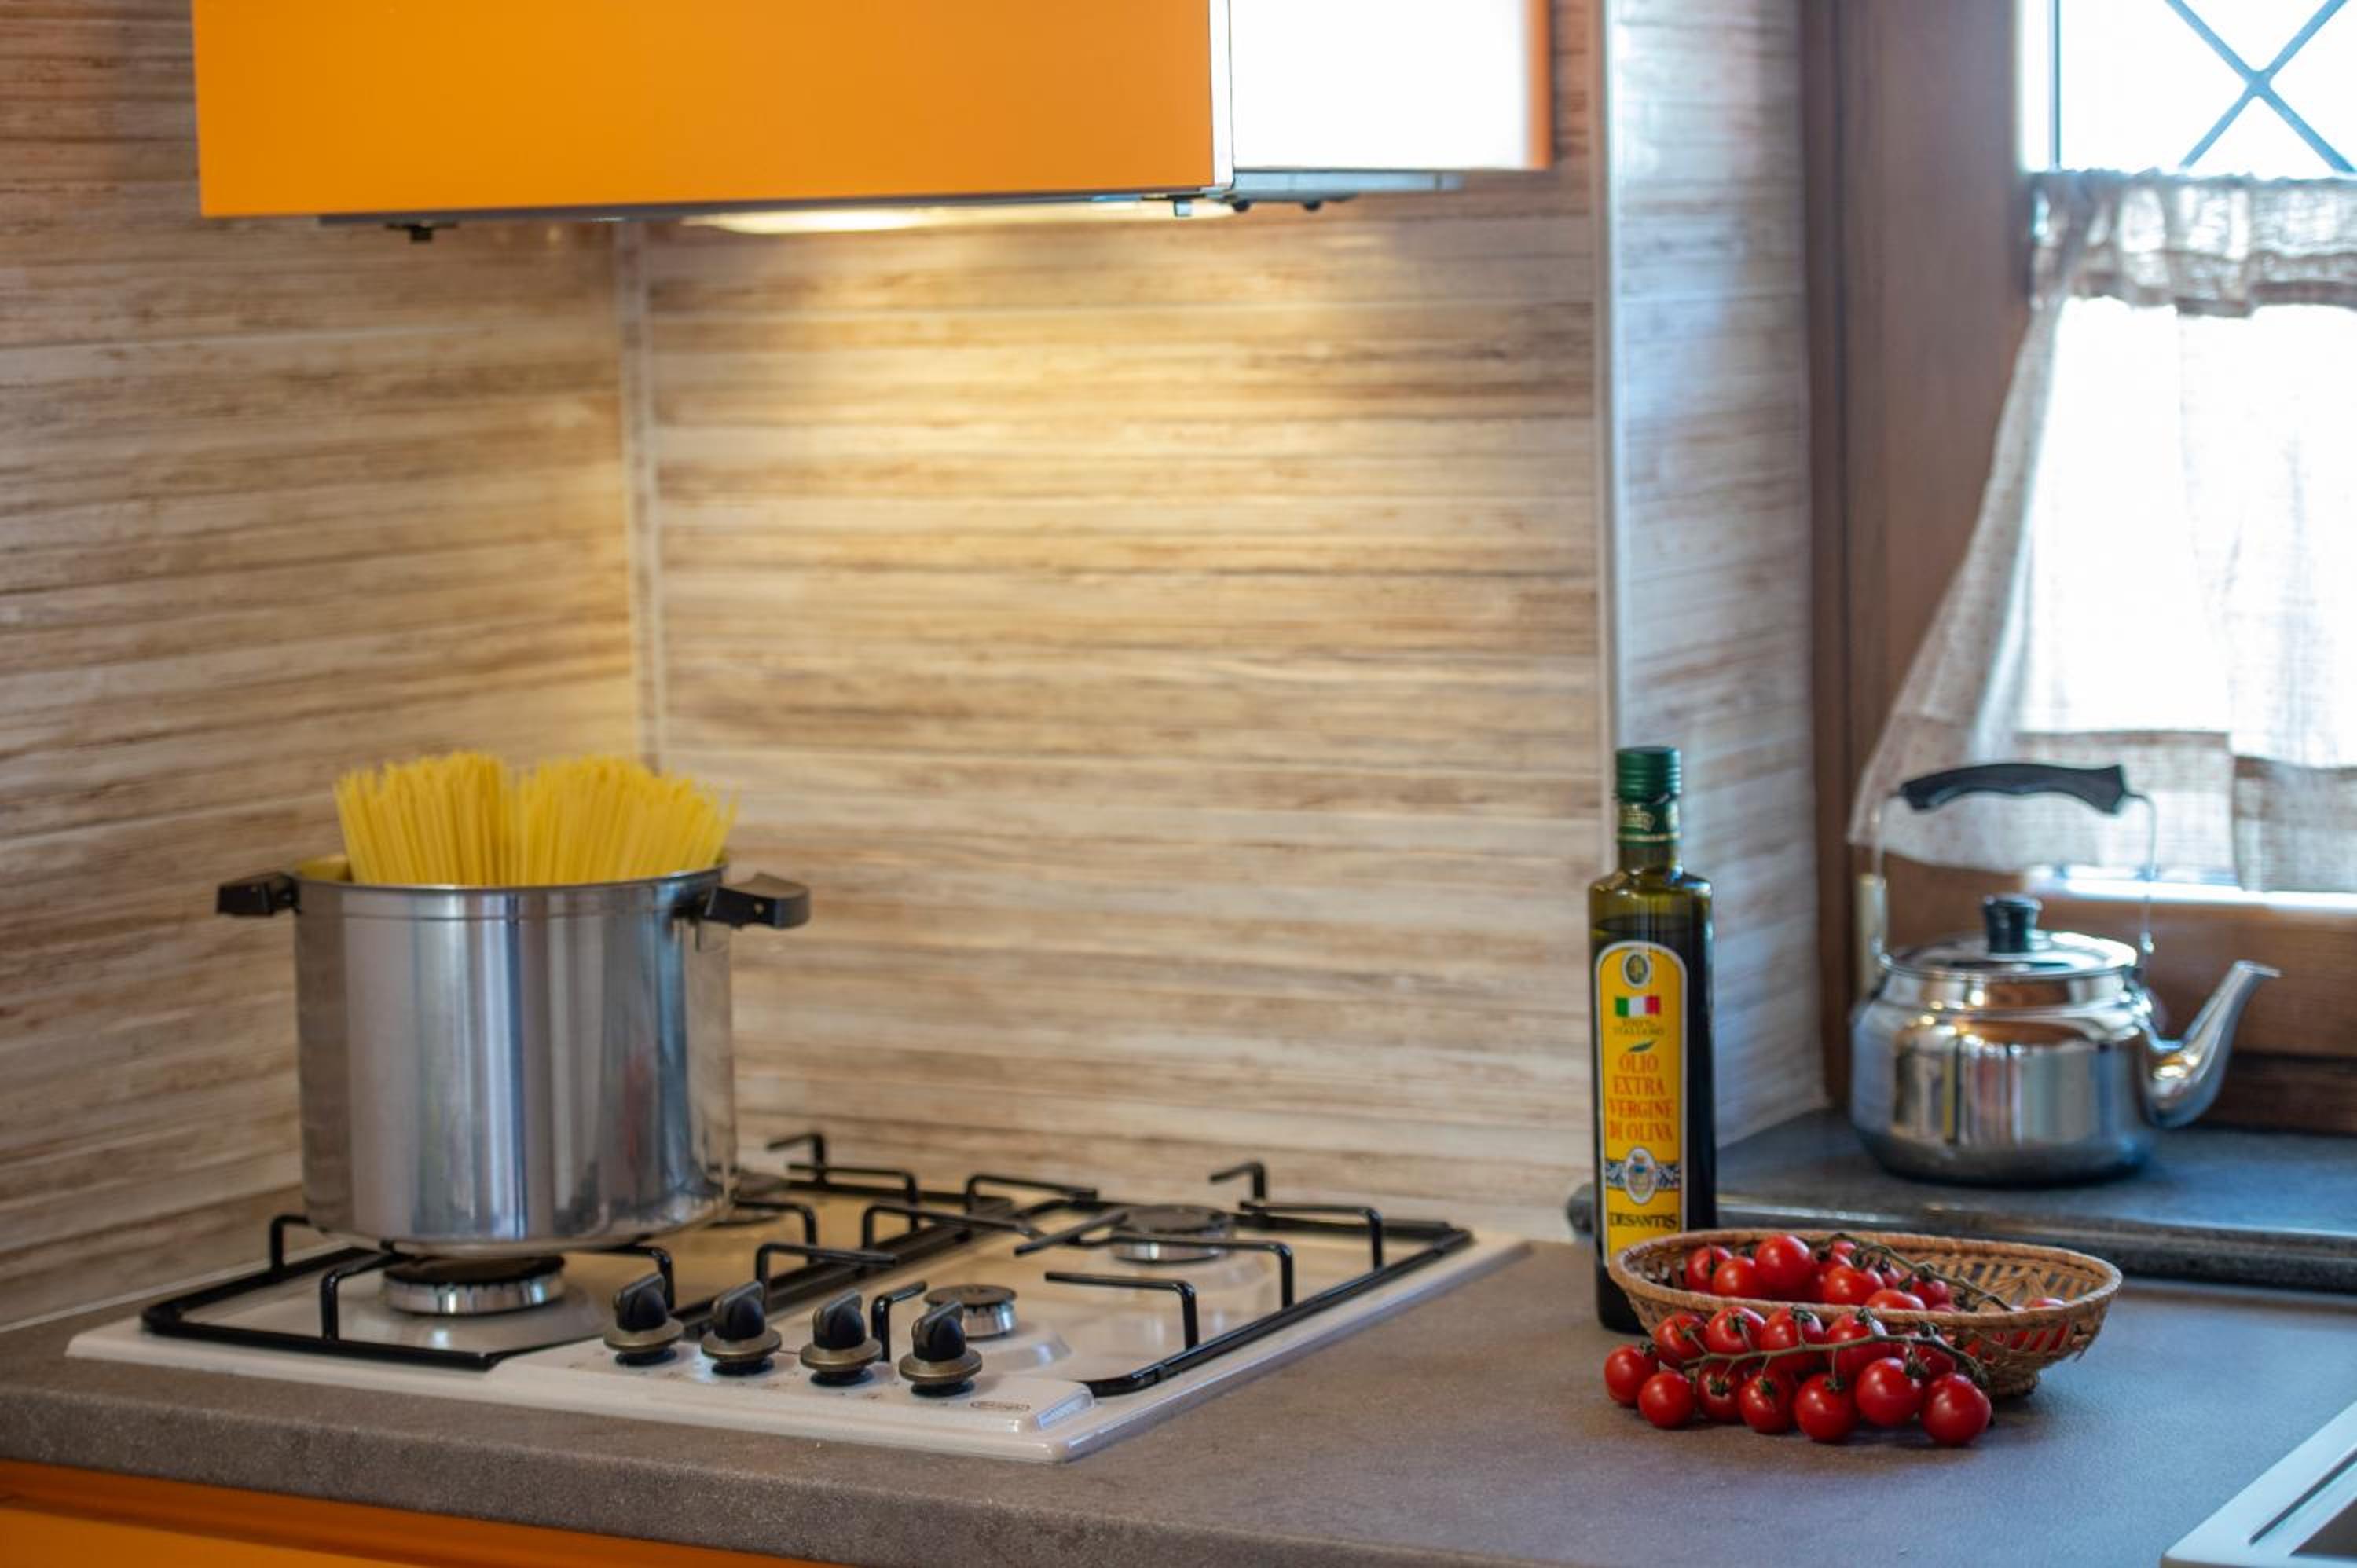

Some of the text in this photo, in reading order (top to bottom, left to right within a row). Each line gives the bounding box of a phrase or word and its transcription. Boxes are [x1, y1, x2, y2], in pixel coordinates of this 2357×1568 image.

[1618, 1053, 1659, 1073] OLIO
[1613, 1075, 1666, 1096] EXTRA
[1608, 1098, 1673, 1119] VERGINE
[1626, 1123, 1673, 1142] OLIVA
